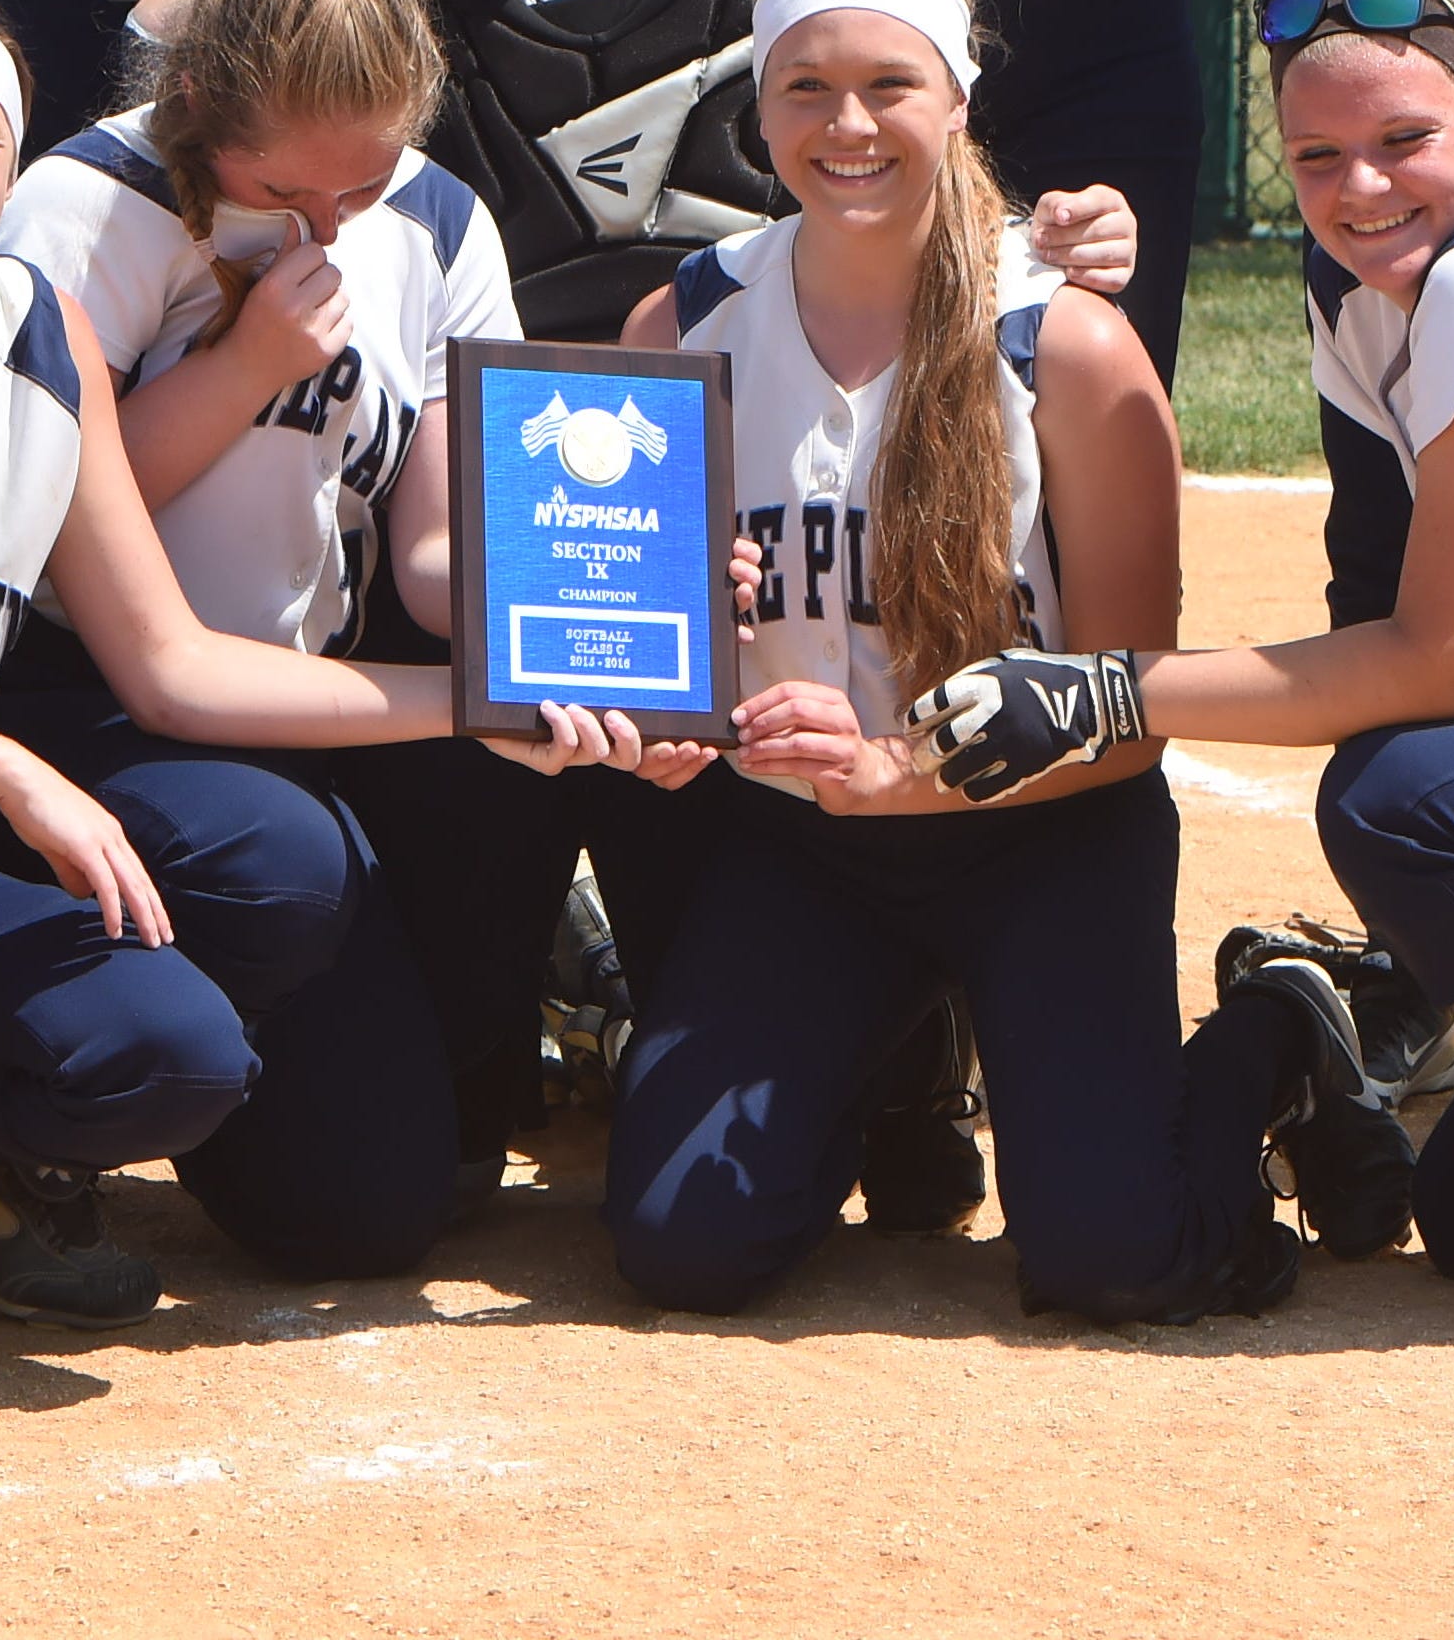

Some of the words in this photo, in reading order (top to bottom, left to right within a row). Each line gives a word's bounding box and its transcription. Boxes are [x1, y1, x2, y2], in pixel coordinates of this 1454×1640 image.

[534, 502, 660, 533] NYSPHSAA
[552, 540, 642, 563] SECTION
[586, 561, 609, 580] IX
[558, 588, 637, 604] CHAMPION
[565, 627, 633, 643] SOFTBALL
[574, 642, 613, 655] CLASS
[616, 644, 626, 656] C
[569, 655, 595, 667] 2015
[604, 657, 631, 669] 2016
